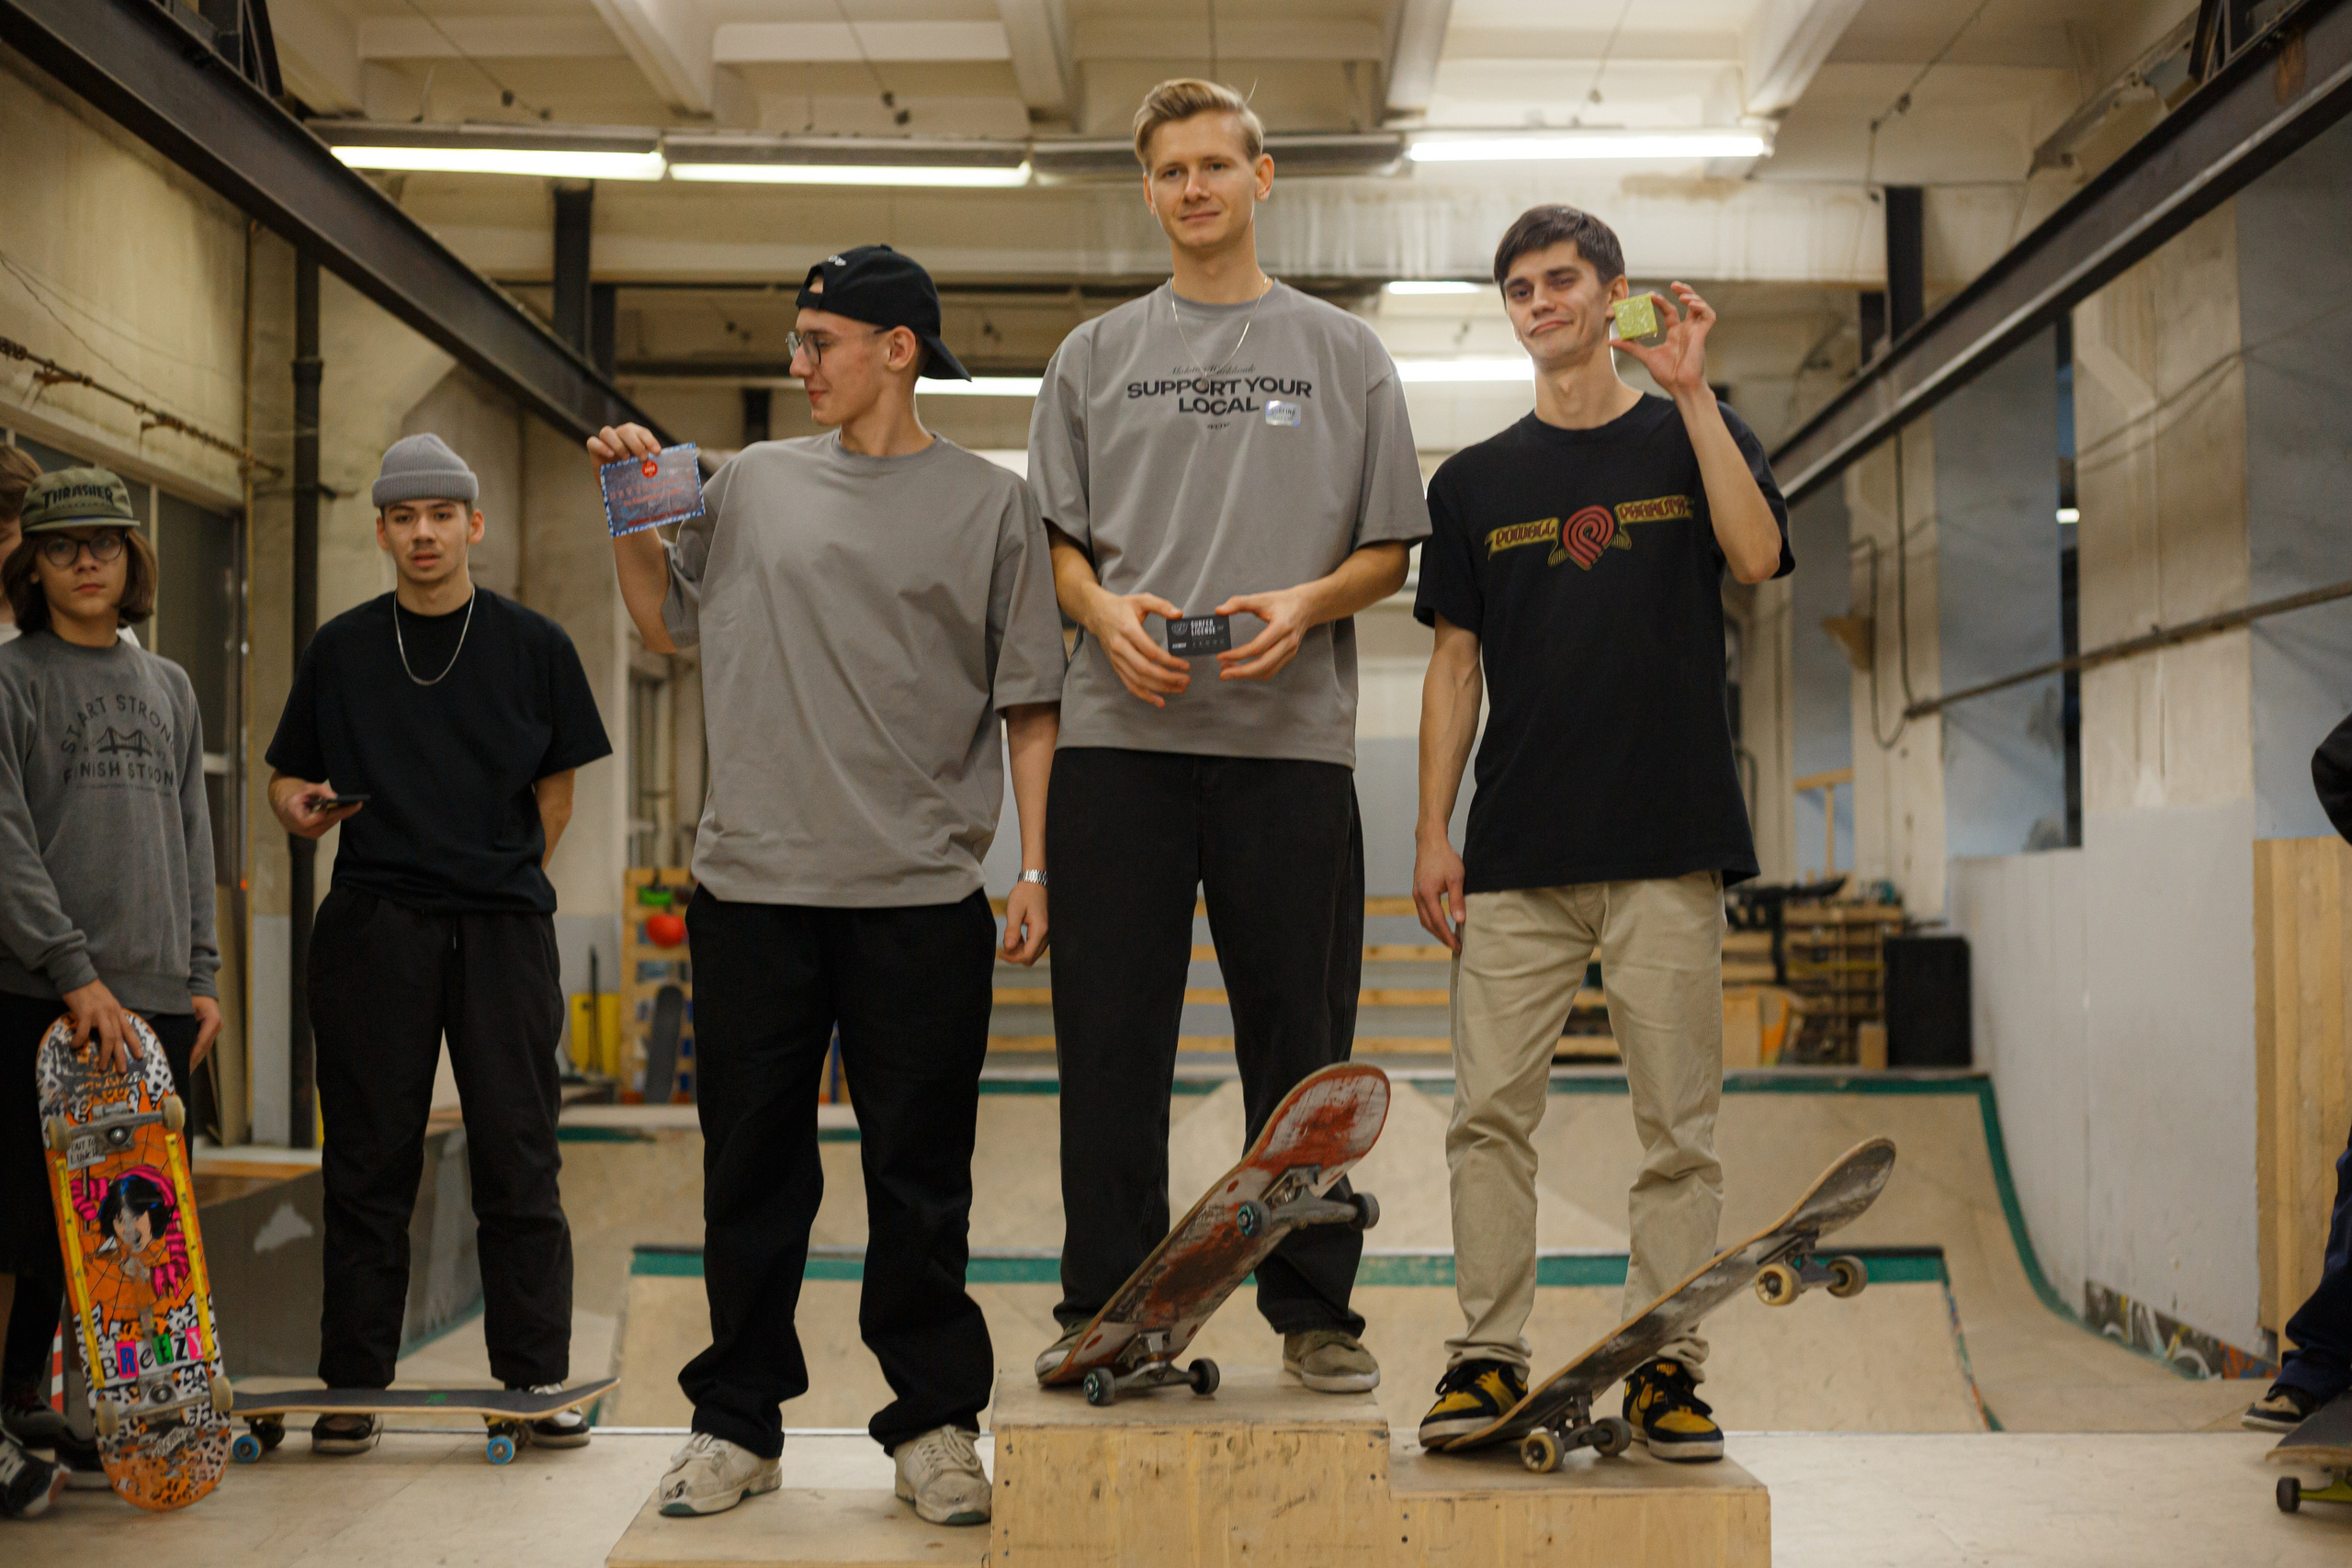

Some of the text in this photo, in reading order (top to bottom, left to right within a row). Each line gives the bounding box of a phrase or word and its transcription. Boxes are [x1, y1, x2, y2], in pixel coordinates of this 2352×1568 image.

[1127, 376, 1313, 399] SUPPORT YOUR
[1178, 397, 1260, 416] LOCAL
[42, 485, 114, 509] THRASHER
[61, 696, 107, 754] START
[63, 760, 120, 785] FINISH
